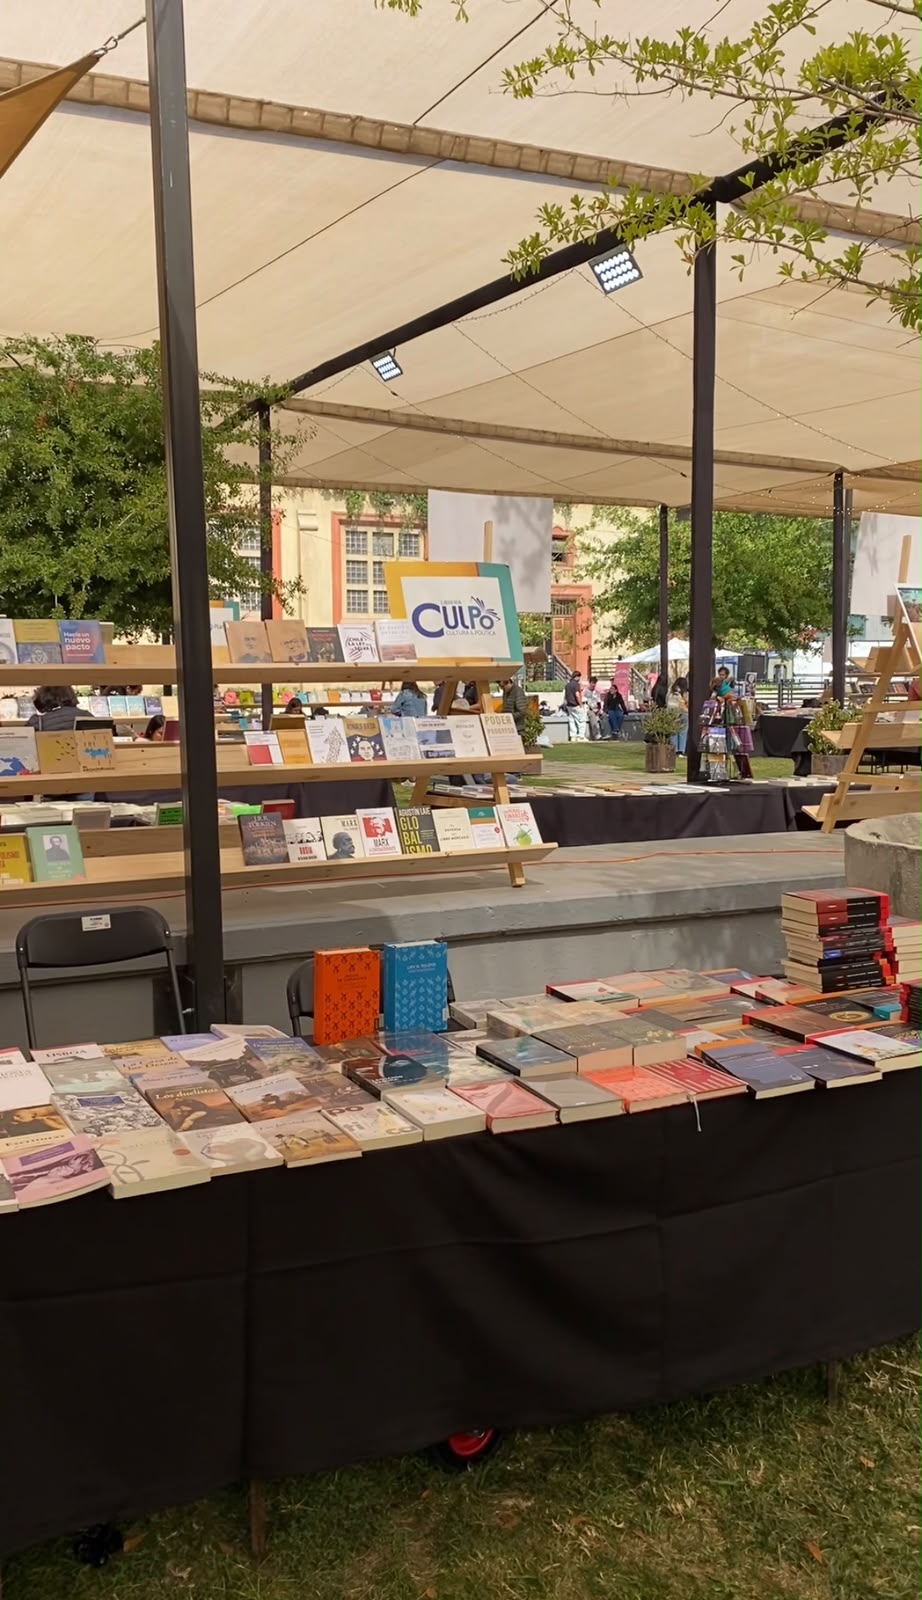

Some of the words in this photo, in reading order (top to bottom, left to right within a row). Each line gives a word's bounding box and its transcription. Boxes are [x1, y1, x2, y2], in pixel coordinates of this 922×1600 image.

[412, 603, 494, 638] CULPO
[65, 643, 90, 651] pacto
[484, 715, 512, 725] PODER
[248, 820, 277, 828] TOLKIEN
[400, 816, 419, 831] GLO
[373, 839, 390, 847] MARX
[403, 831, 423, 845] BAL
[155, 1092, 176, 1100] Los
[176, 1088, 219, 1099] duelistas
